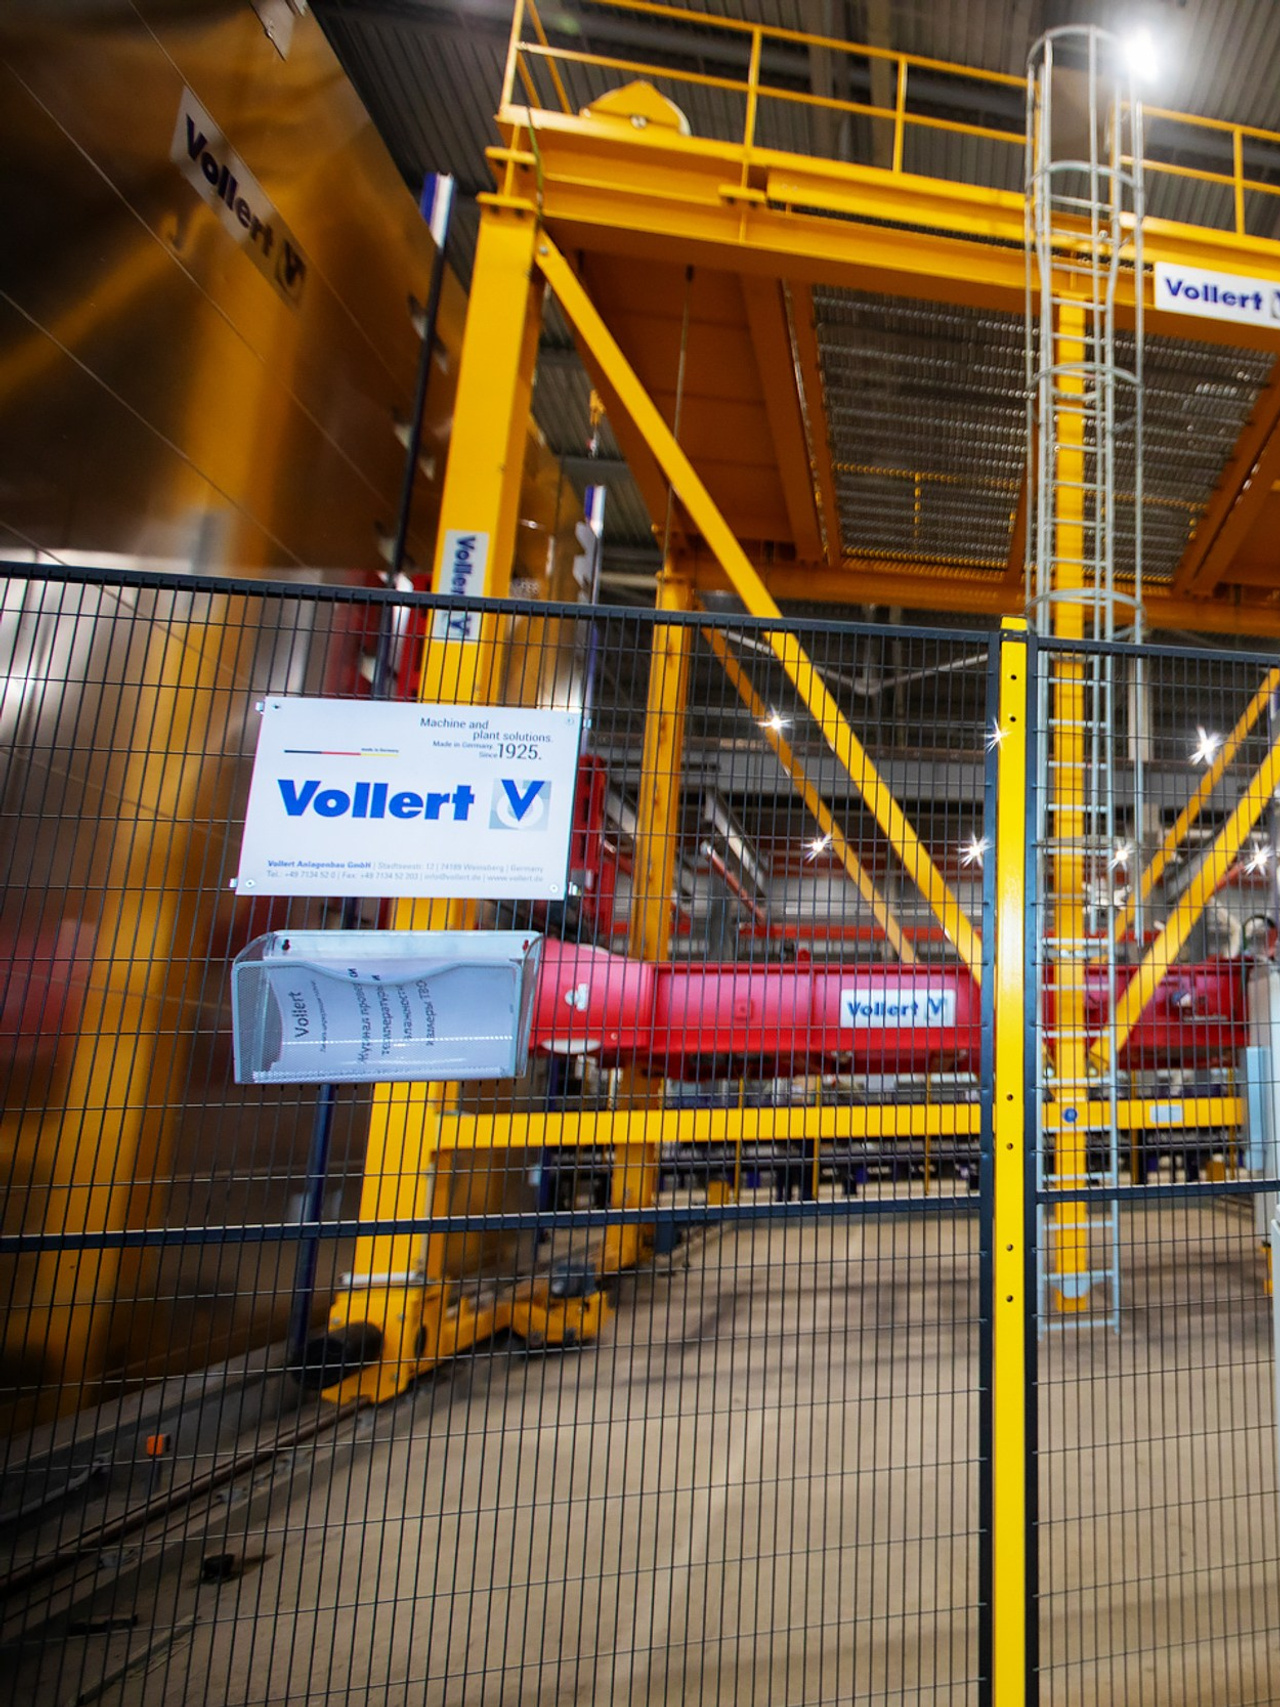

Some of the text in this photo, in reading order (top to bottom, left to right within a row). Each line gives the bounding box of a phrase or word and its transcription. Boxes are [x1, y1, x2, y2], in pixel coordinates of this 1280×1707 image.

[186, 113, 273, 258] Vollert
[1165, 277, 1263, 311] Vollert
[452, 536, 476, 595] Voller
[420, 717, 489, 730] Machine and
[432, 740, 452, 748] Made
[472, 729, 500, 741] plant
[479, 742, 542, 760] Since 1925.
[277, 779, 475, 821] Vollert
[267, 860, 295, 868] Vollert
[296, 861, 346, 870] Anlagenbau
[347, 861, 372, 869] GmbH
[288, 991, 310, 1038] Vollert
[847, 1001, 918, 1016] Vollert
